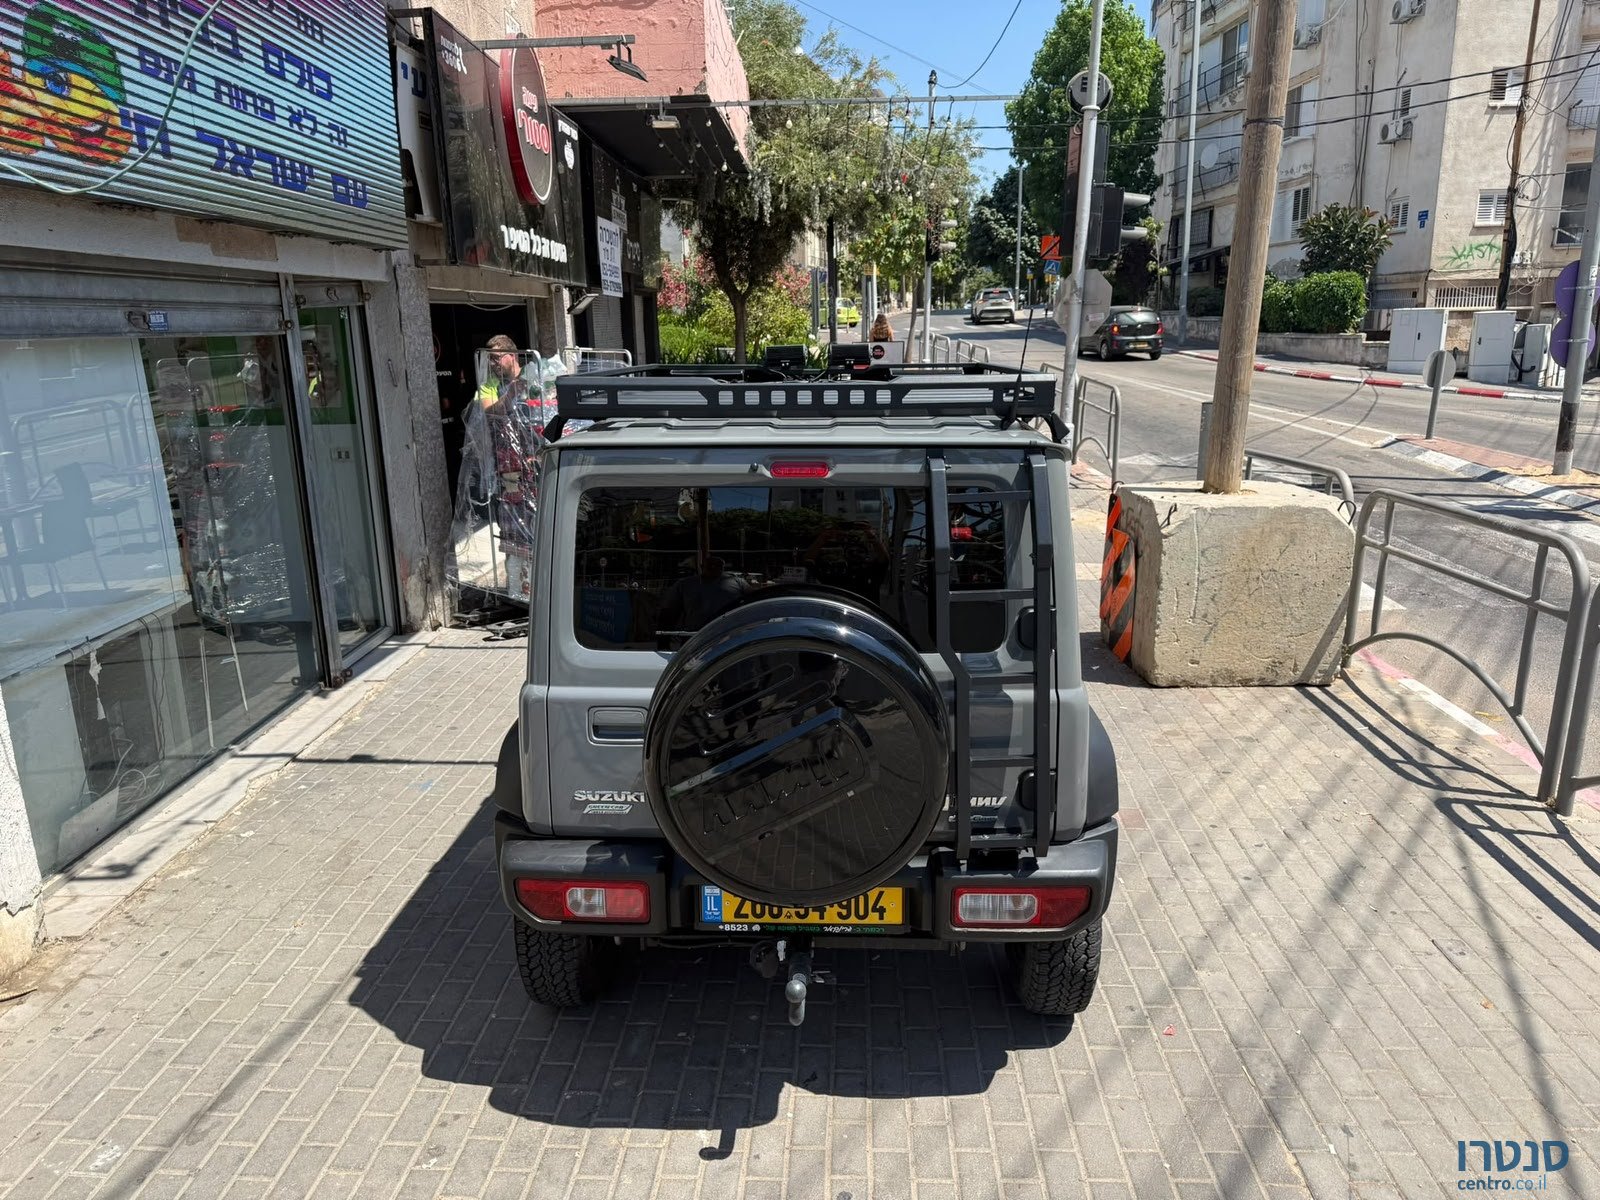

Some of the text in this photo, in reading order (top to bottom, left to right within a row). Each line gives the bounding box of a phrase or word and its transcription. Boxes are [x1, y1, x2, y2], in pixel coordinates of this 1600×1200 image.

[261, 40, 333, 101] כולם
[214, 75, 277, 123] פחות
[288, 104, 318, 136] לא
[328, 121, 348, 149] זה
[517, 108, 551, 154] סטורי
[119, 107, 369, 209] עם ישראל חי
[500, 224, 531, 254] הסיפור
[529, 228, 542, 256] כל
[574, 789, 646, 803] SUZUKI
[706, 896, 719, 911] IL
